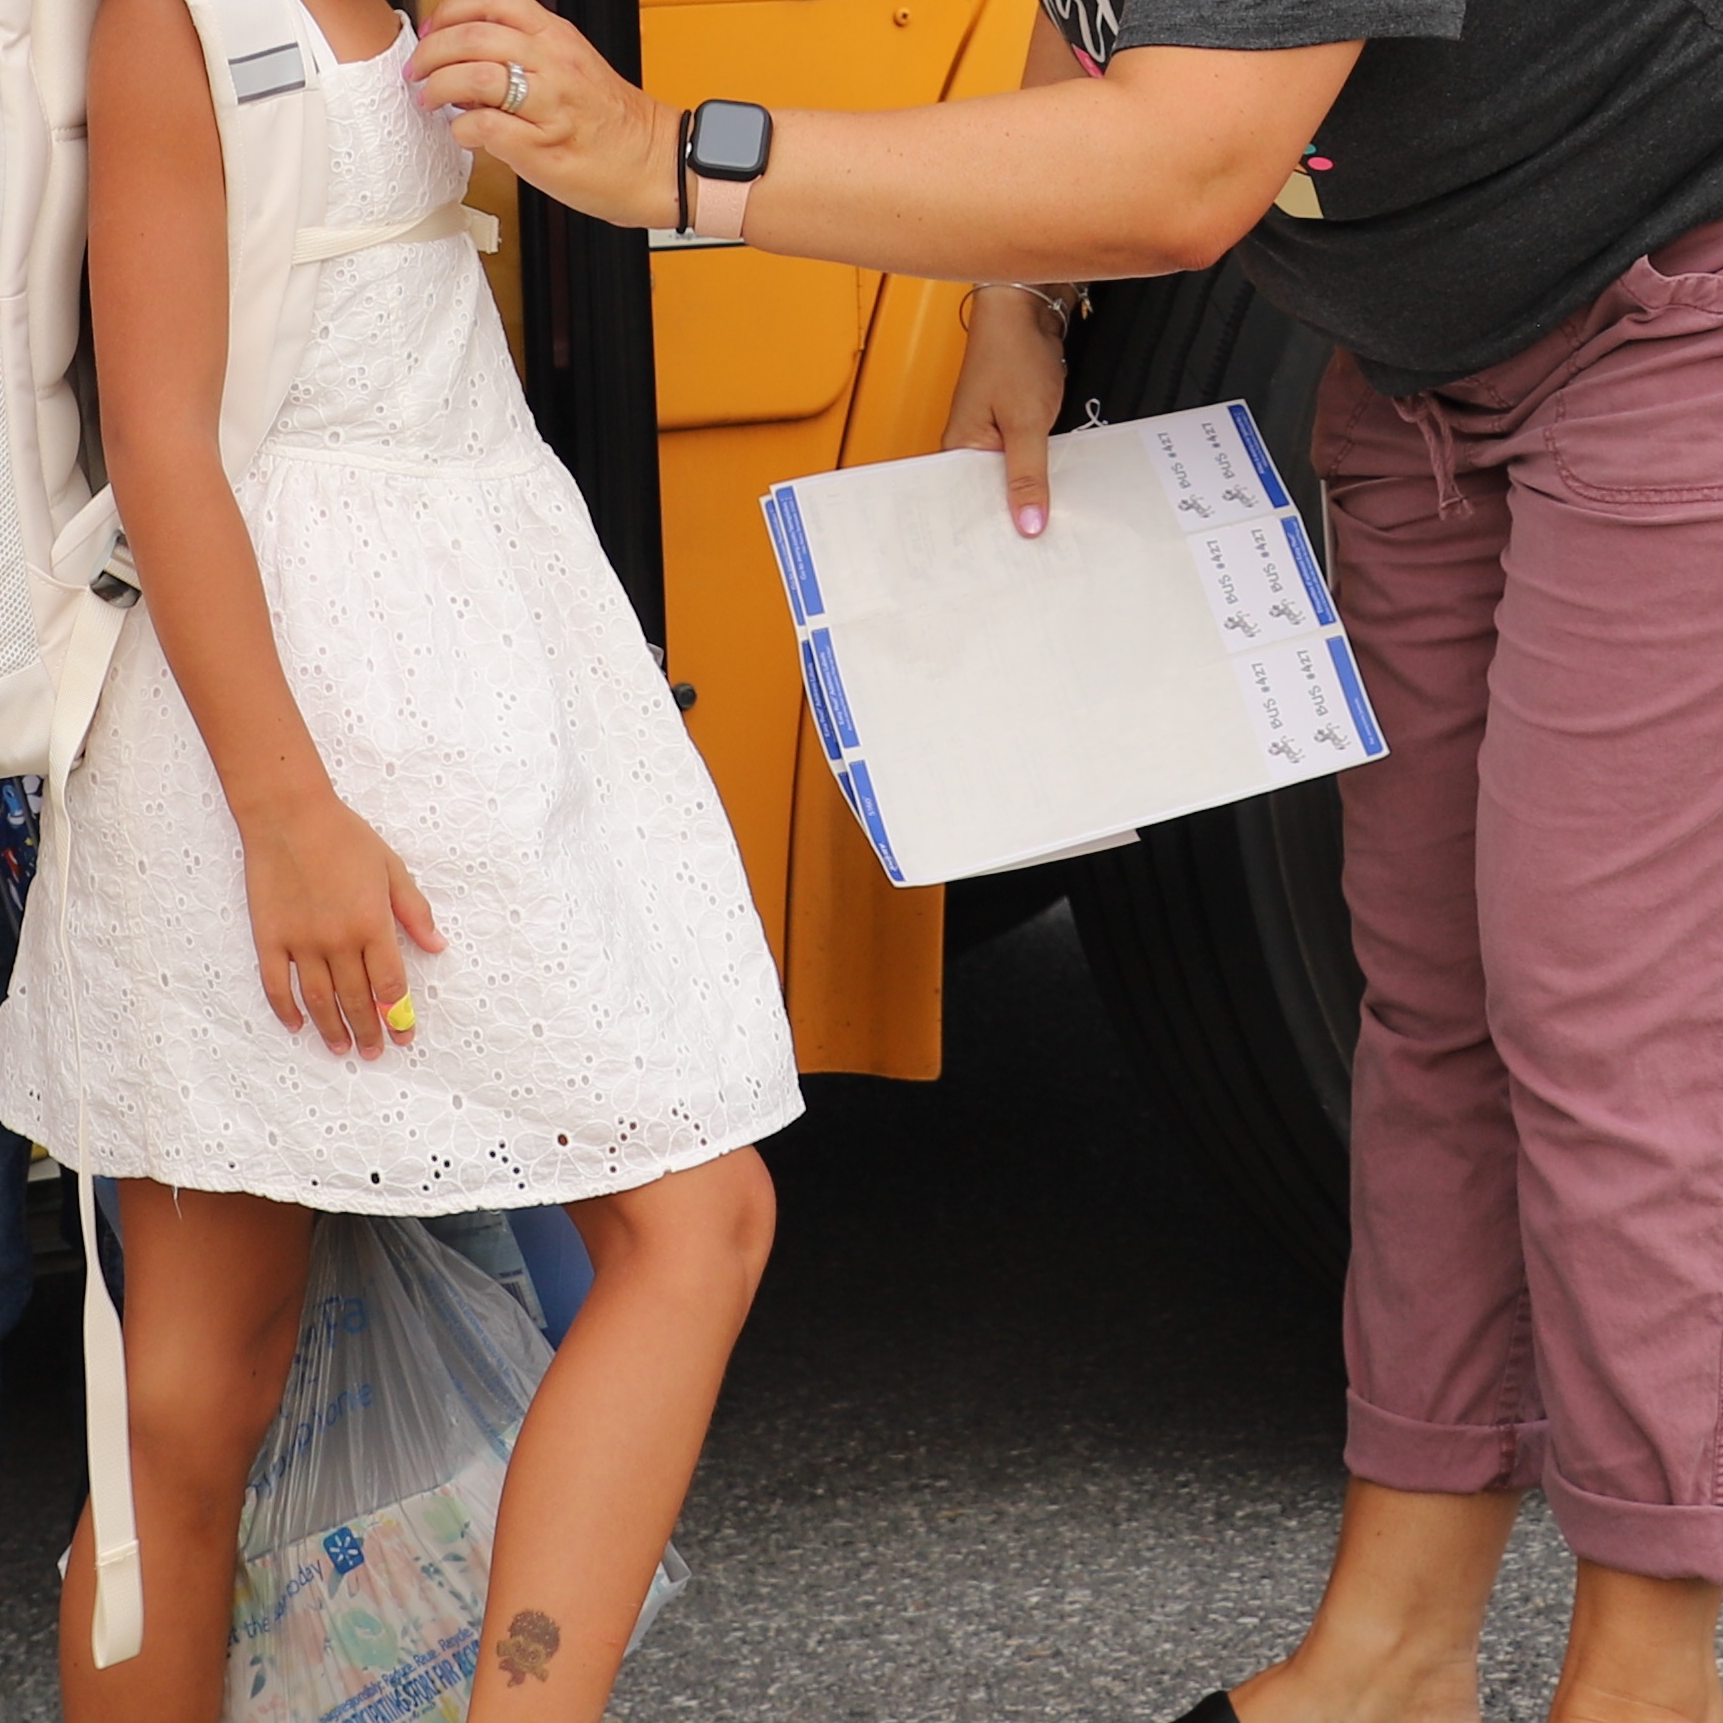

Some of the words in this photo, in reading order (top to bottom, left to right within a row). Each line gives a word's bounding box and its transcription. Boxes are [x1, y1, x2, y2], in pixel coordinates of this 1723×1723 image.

[1157, 431, 1176, 459] #427
[1201, 421, 1221, 449] #427
[1171, 461, 1191, 490] BUS
[1215, 452, 1235, 481] BUS
[1206, 539, 1225, 570] #427
[1251, 528, 1269, 559] #427
[1218, 574, 1238, 606] BUS
[1263, 562, 1283, 594] BUS
[1251, 662, 1270, 693] #427
[1297, 649, 1315, 680] #427
[1263, 698, 1283, 730] BUS
[1309, 685, 1329, 718] BUS
